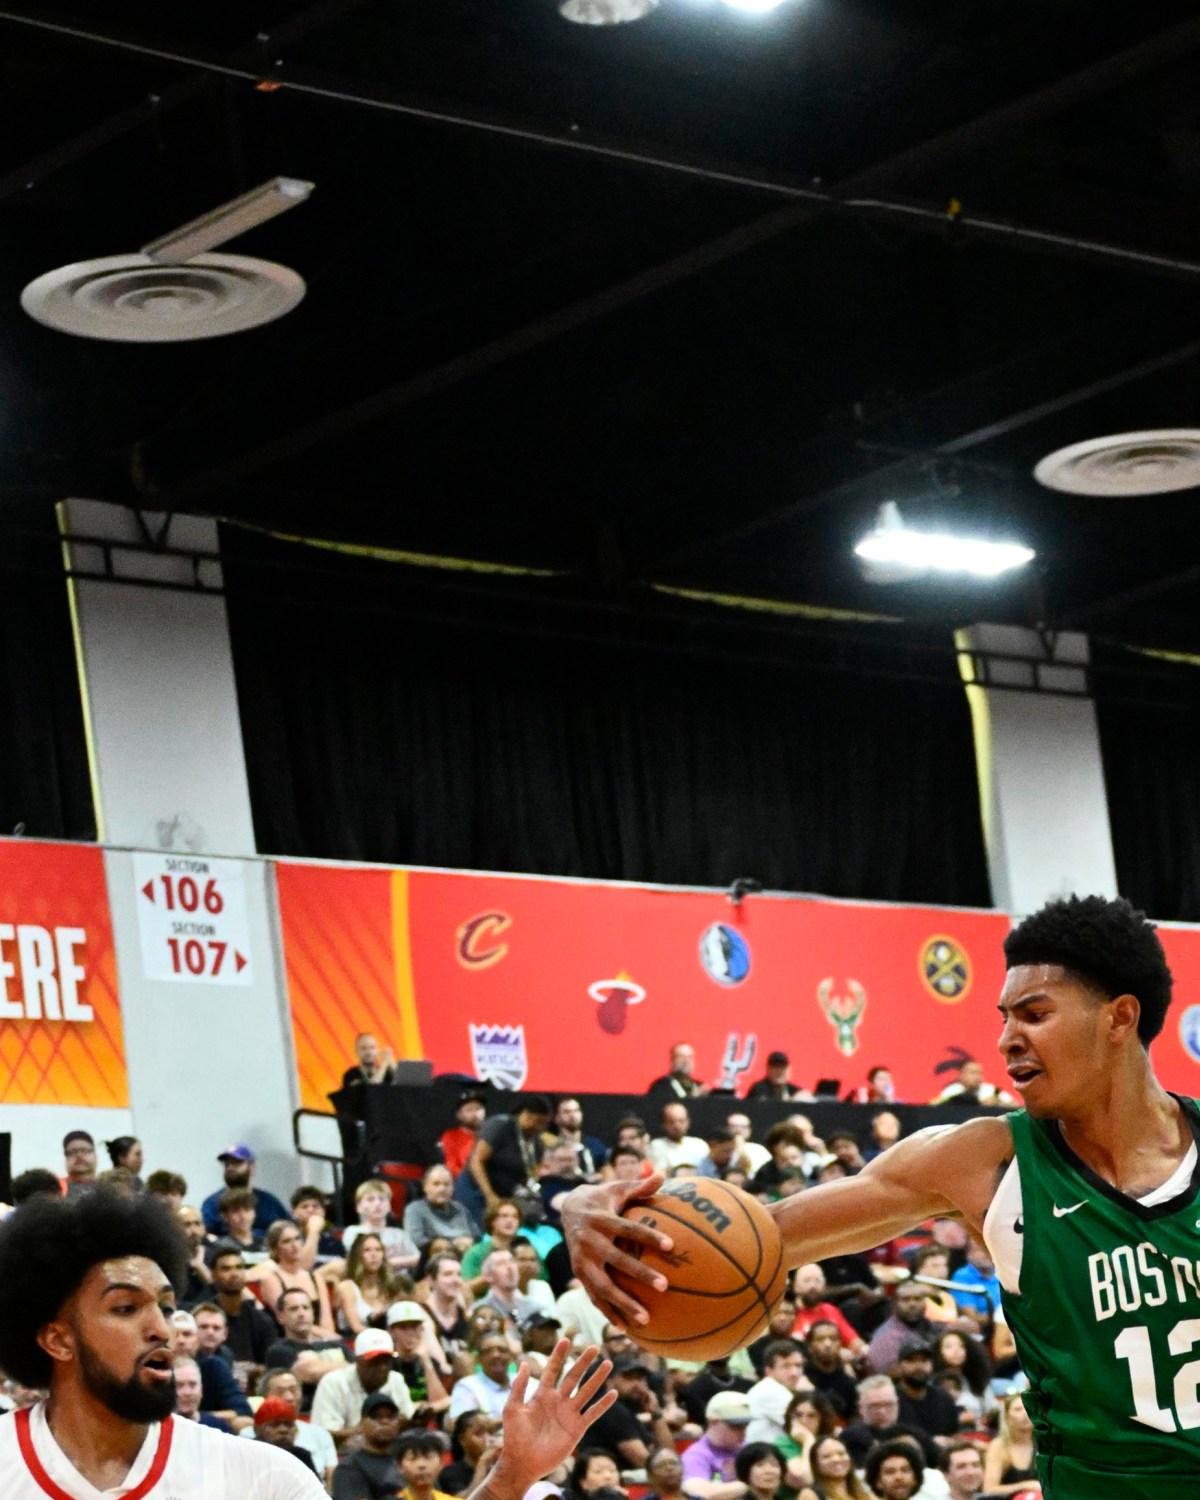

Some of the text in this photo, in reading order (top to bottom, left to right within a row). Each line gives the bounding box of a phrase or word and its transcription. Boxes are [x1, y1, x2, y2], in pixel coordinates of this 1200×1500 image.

[166, 859, 209, 873] SECTION
[161, 875, 224, 914] 106
[172, 922, 216, 936] SECTION
[167, 939, 227, 976] 107
